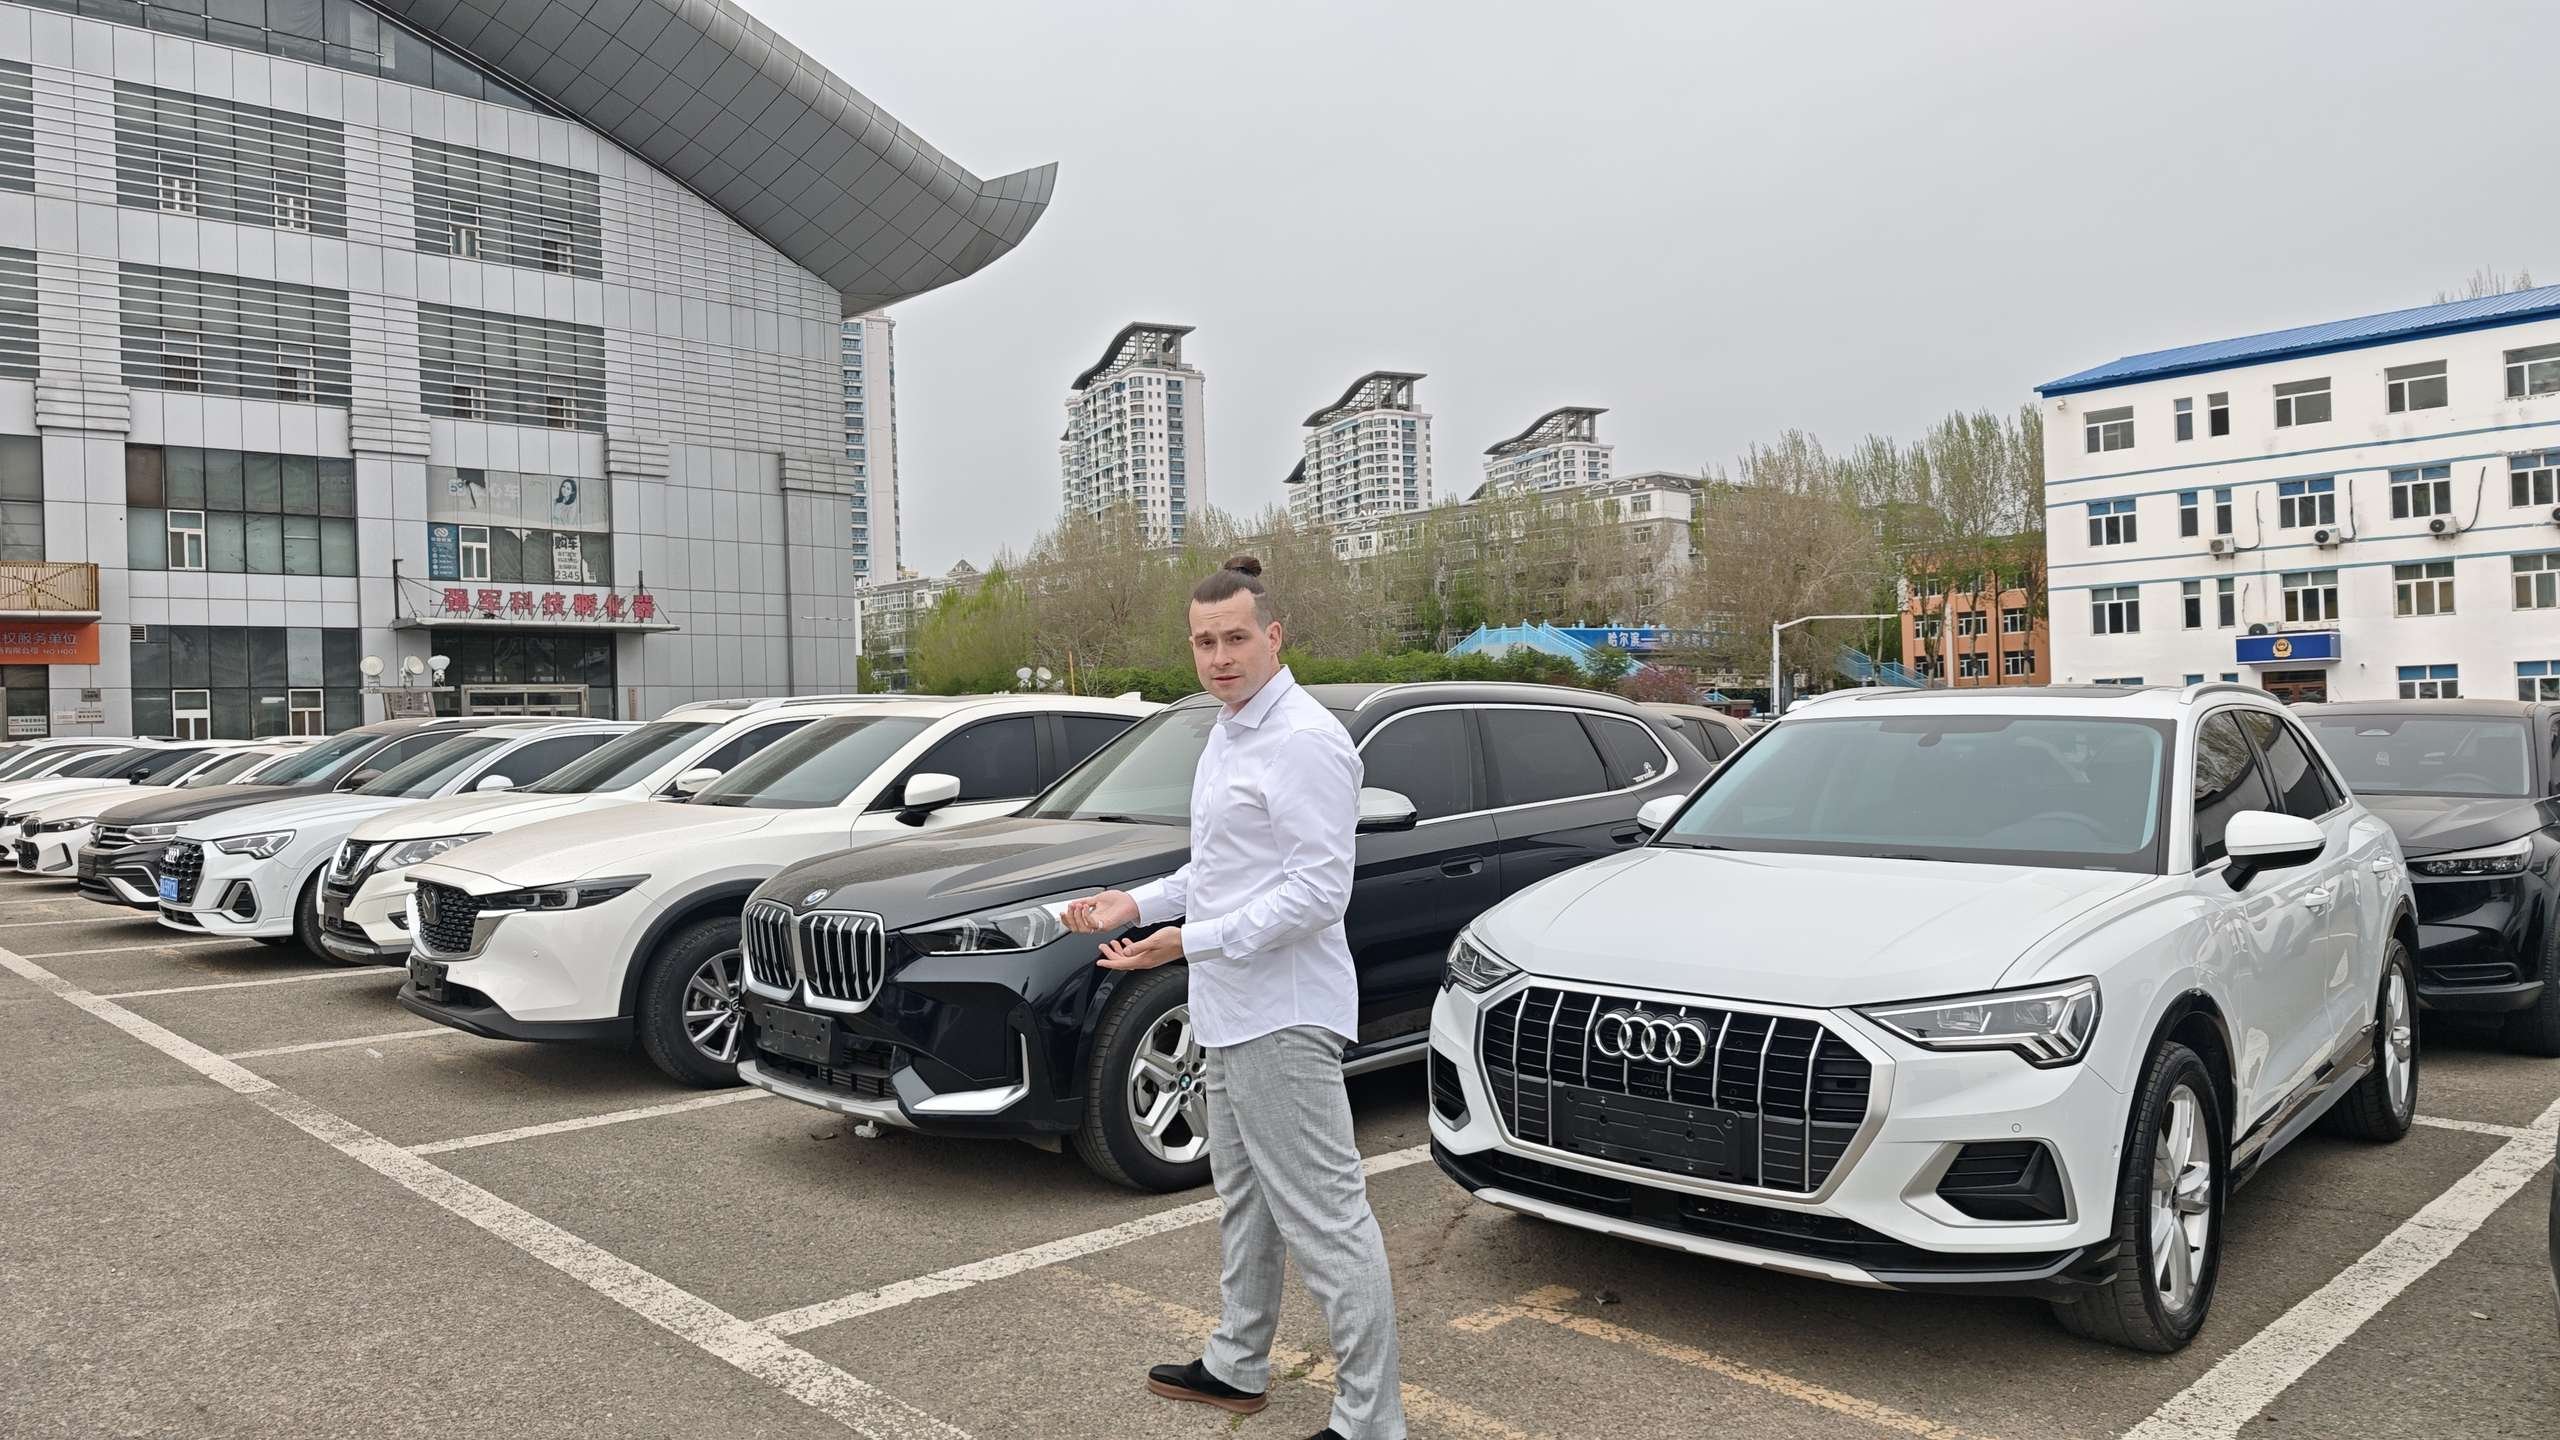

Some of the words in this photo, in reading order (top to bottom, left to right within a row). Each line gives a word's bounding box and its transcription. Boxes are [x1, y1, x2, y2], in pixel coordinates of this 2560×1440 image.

[554, 535, 578, 550] 购车
[555, 571, 580, 580] 2345
[444, 588, 655, 619] 强军科技孵化器
